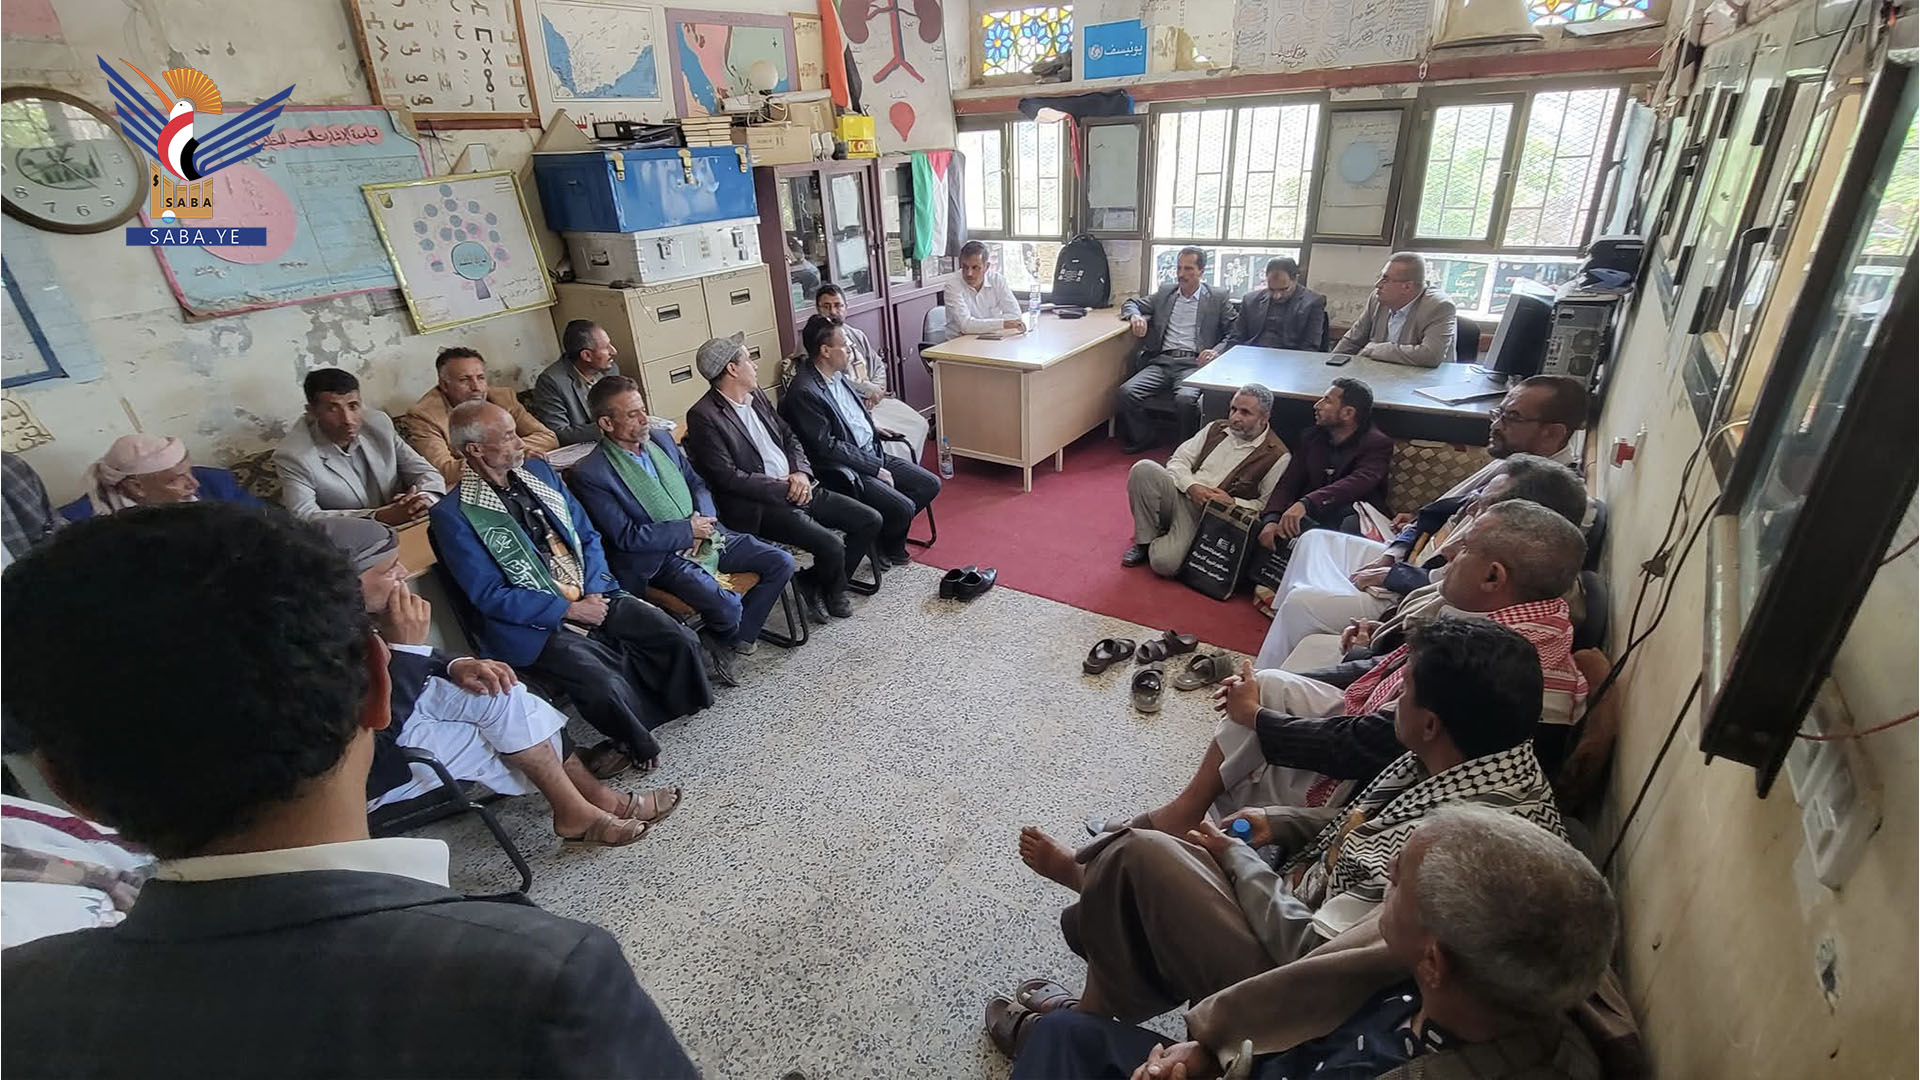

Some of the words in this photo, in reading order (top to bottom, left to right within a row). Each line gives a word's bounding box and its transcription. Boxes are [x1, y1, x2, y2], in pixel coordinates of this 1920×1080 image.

[1104, 41, 1143, 57] يونيسف
[114, 177, 125, 188] 4
[42, 200, 56, 214] 7
[100, 195, 115, 208] 5
[76, 204, 91, 217] 6
